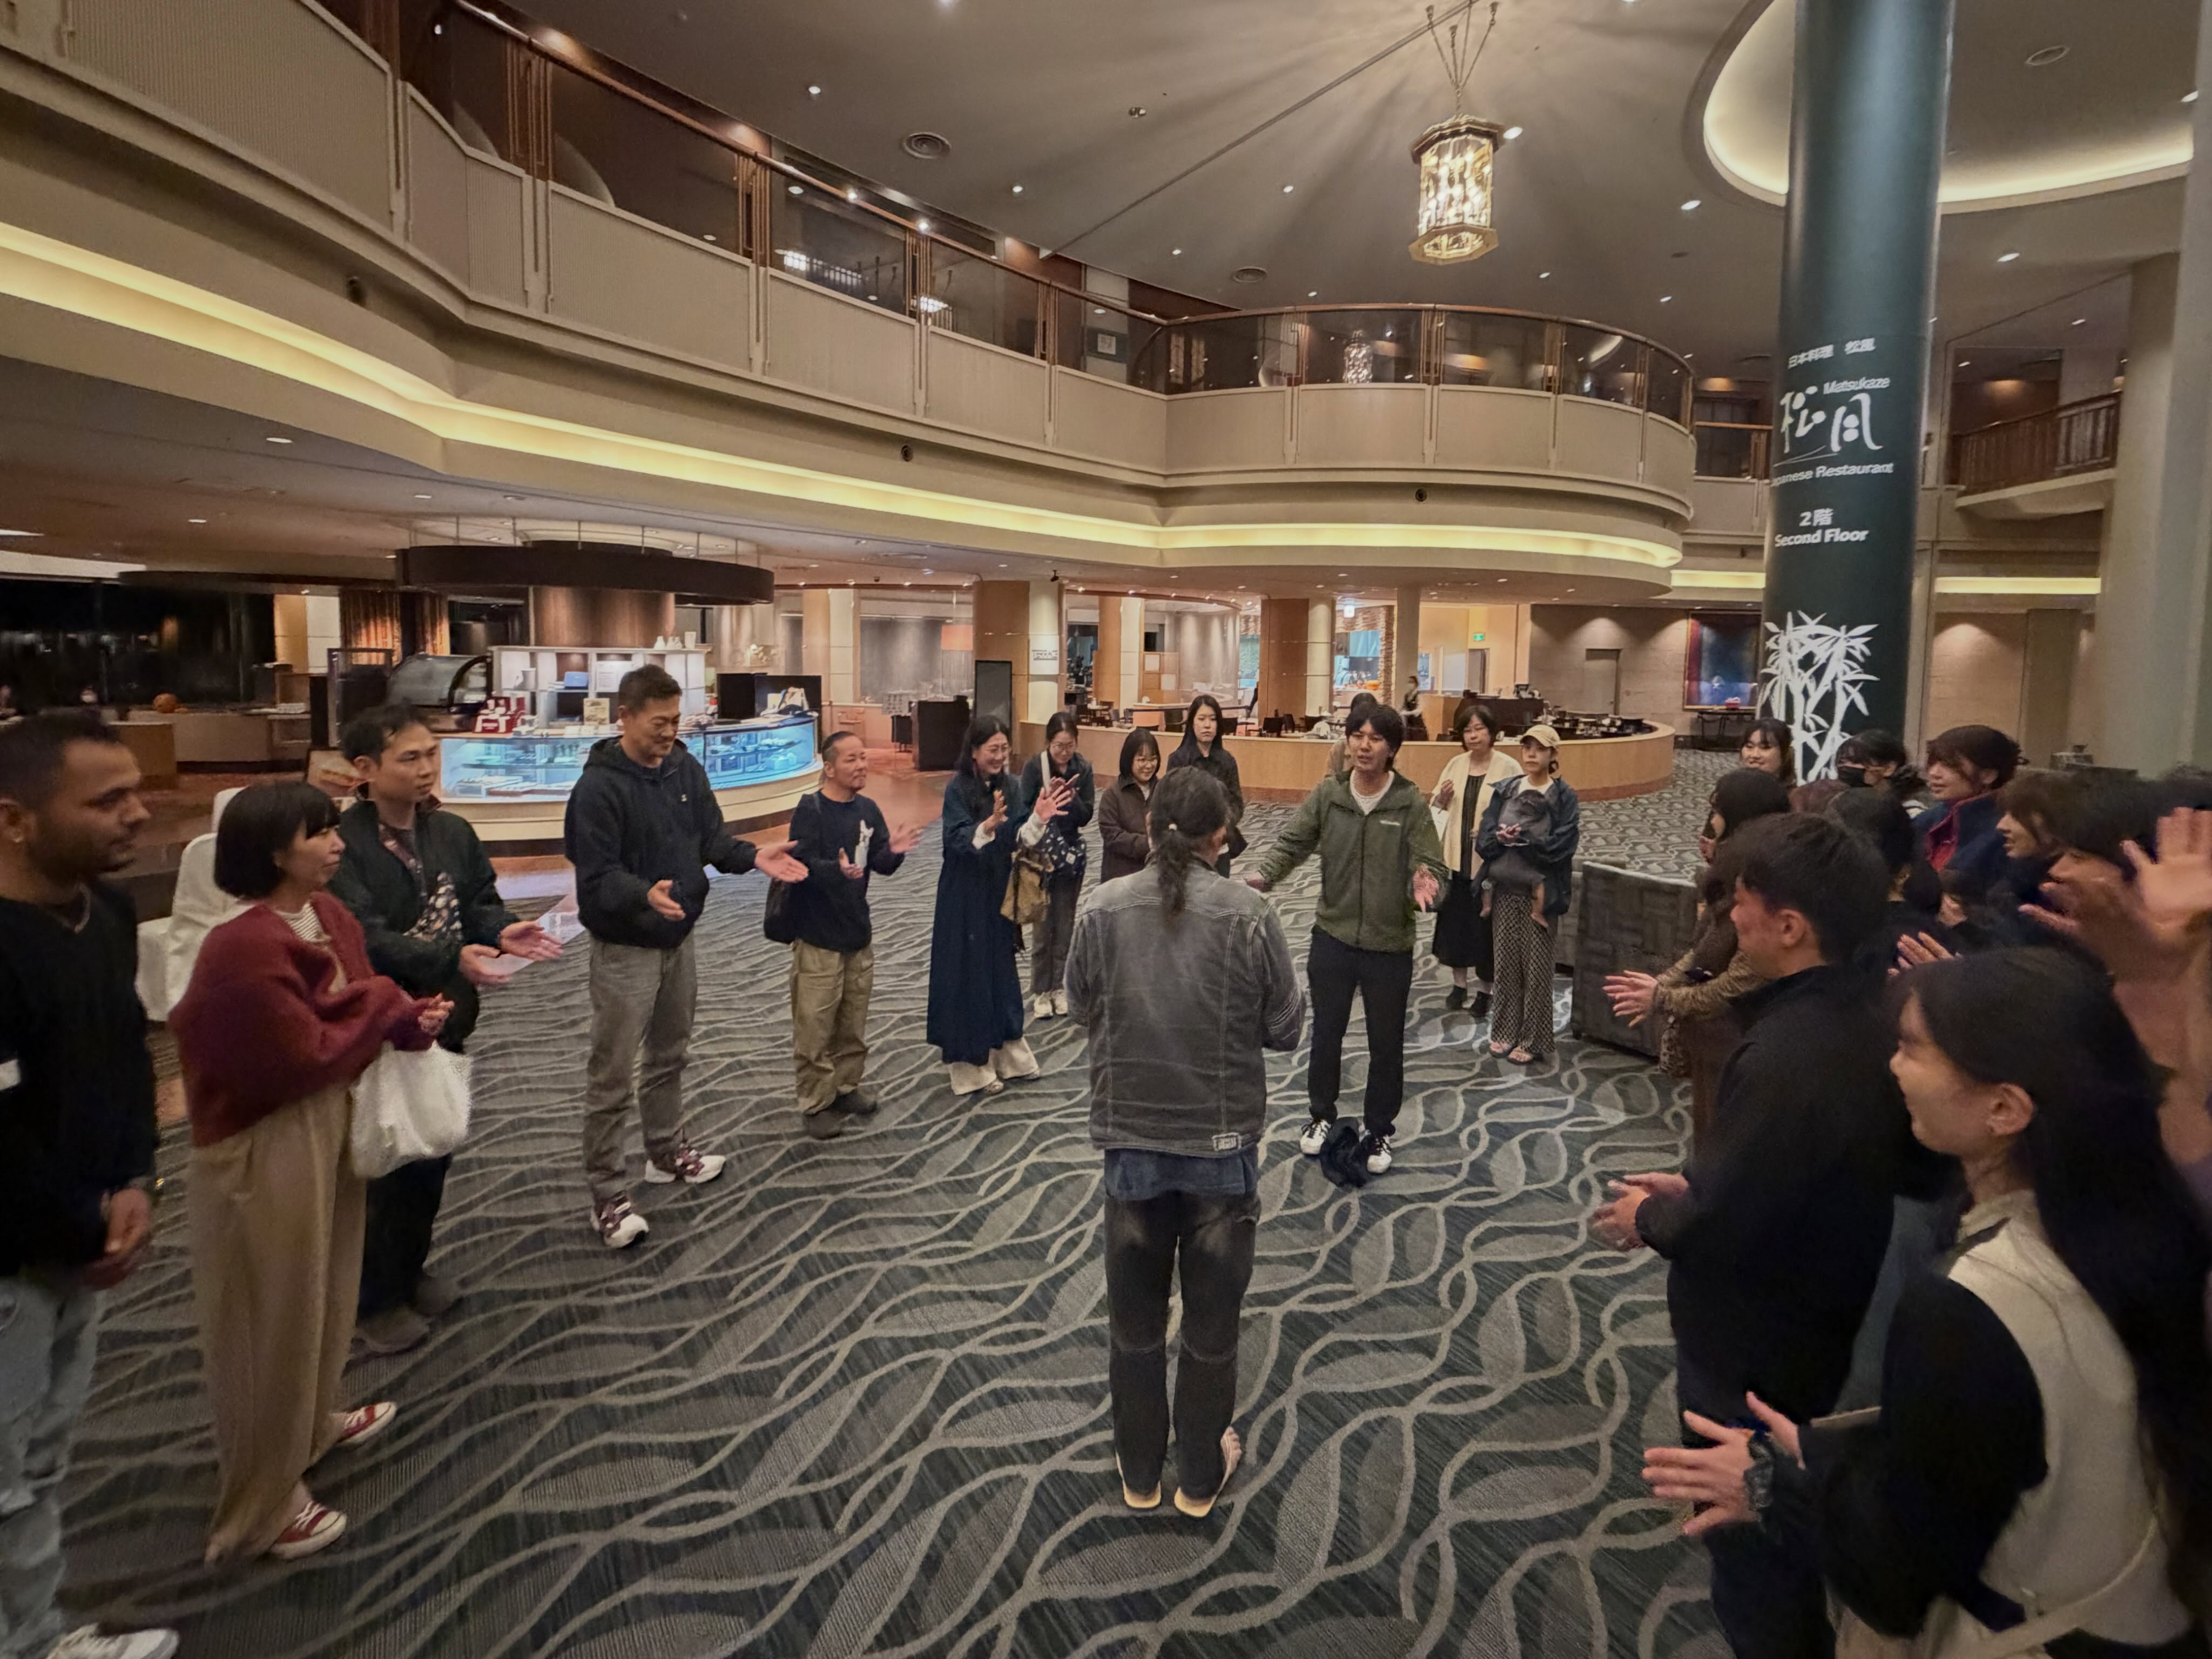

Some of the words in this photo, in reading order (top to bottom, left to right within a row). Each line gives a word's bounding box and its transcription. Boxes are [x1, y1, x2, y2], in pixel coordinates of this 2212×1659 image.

[1823, 377, 1890, 395] Matsukaze
[1816, 463, 1893, 478] Restaurant
[1799, 508, 1834, 527] 2階
[1775, 529, 1823, 548] Second
[1824, 528, 1869, 542] Floor
